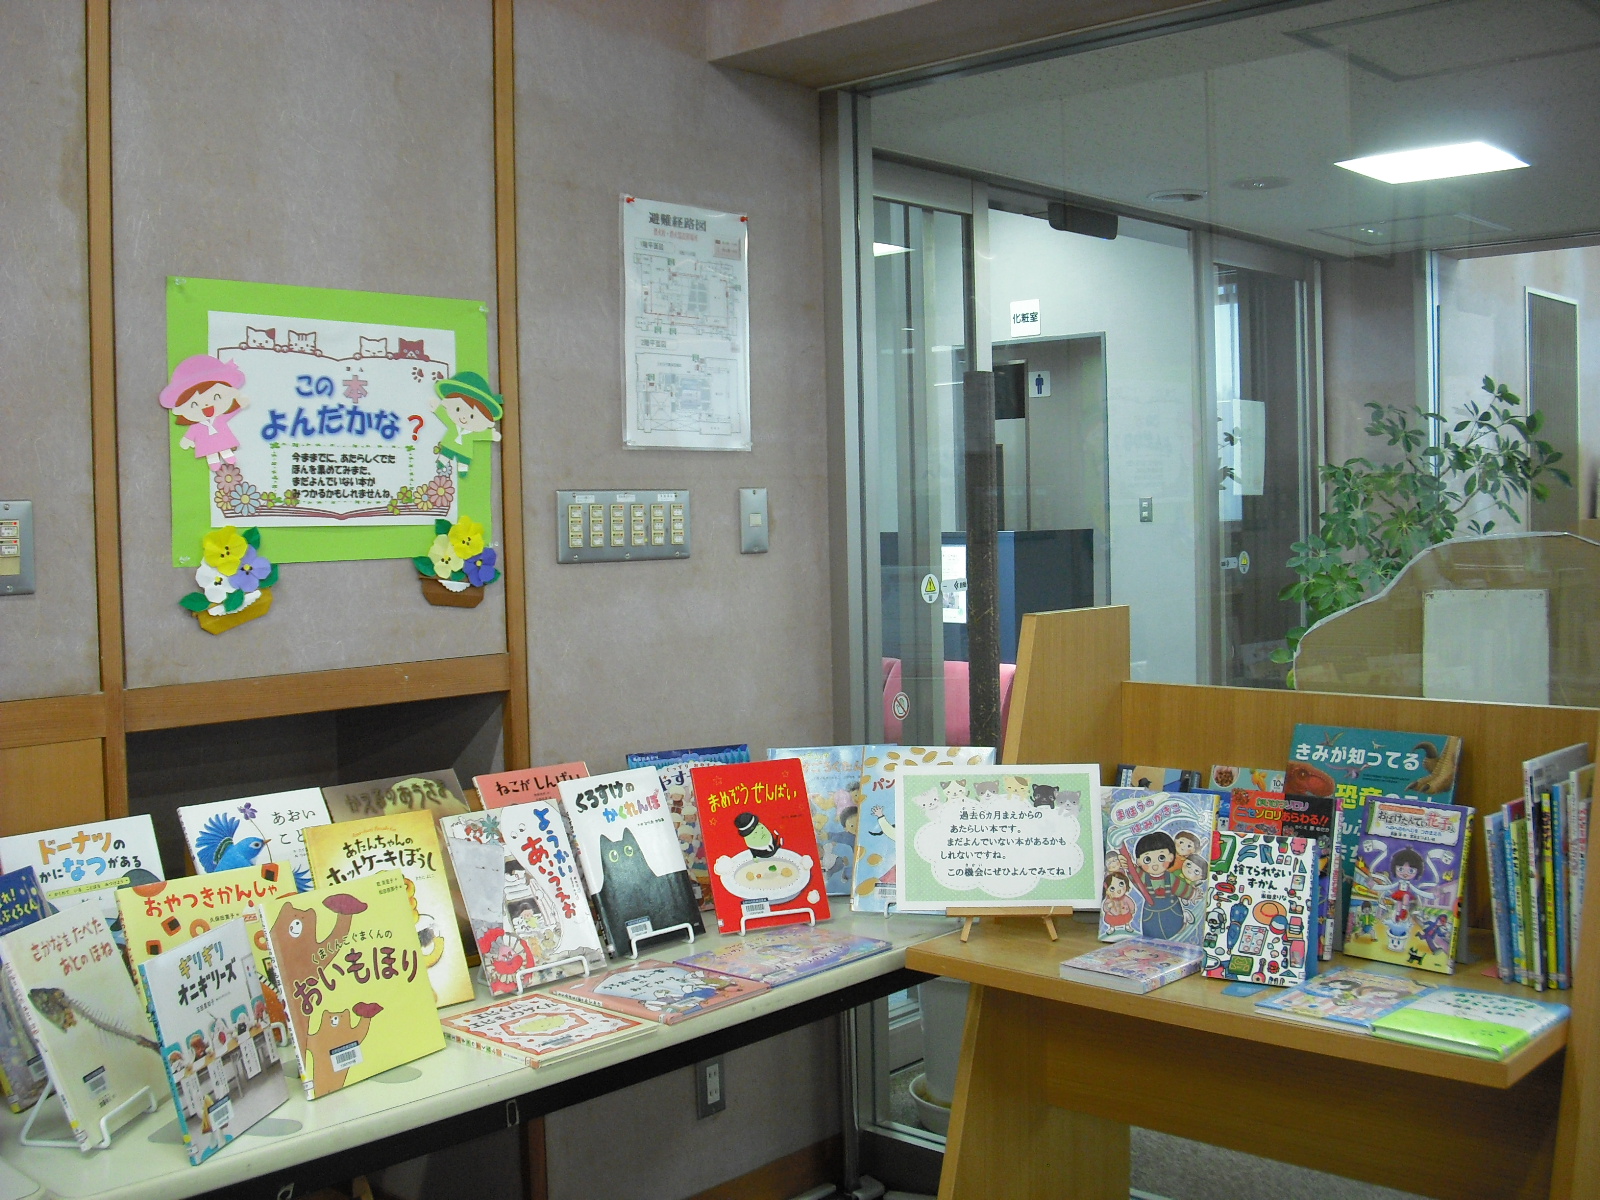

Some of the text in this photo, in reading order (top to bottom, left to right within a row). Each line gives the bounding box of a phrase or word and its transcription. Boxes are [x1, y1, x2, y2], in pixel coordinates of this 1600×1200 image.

[1012, 311, 1039, 324] 化粧室
[292, 476, 376, 487] まだよんでいない本が
[292, 488, 394, 499] みつかるかもしれませんね。
[1295, 743, 1420, 771] きみが知ってる
[574, 780, 636, 814] くろすけの
[602, 788, 661, 824] かくれんぼ
[707, 782, 797, 812] まめぞう せんぱい
[271, 808, 316, 826] あおい
[949, 824, 1022, 834] あたらしい本です。
[38, 830, 126, 866] ドーナツの
[342, 834, 414, 859] あたんちゃんの
[940, 850, 1007, 860] しれないですね。
[946, 836, 1067, 847] まだよんでいない本があるかも
[39, 855, 142, 885] かになつがある
[326, 847, 437, 887] ホットケーキぼうし
[520, 836, 577, 919] あいうえお
[1233, 863, 1292, 879] 捨てられない
[143, 880, 278, 918] おやつきかんしゃ
[178, 940, 225, 980] ギリギリ
[311, 929, 393, 964] くまくんこぐまくんの
[177, 956, 238, 1006] オニギリーズ
[292, 946, 419, 1016] おいもほり
